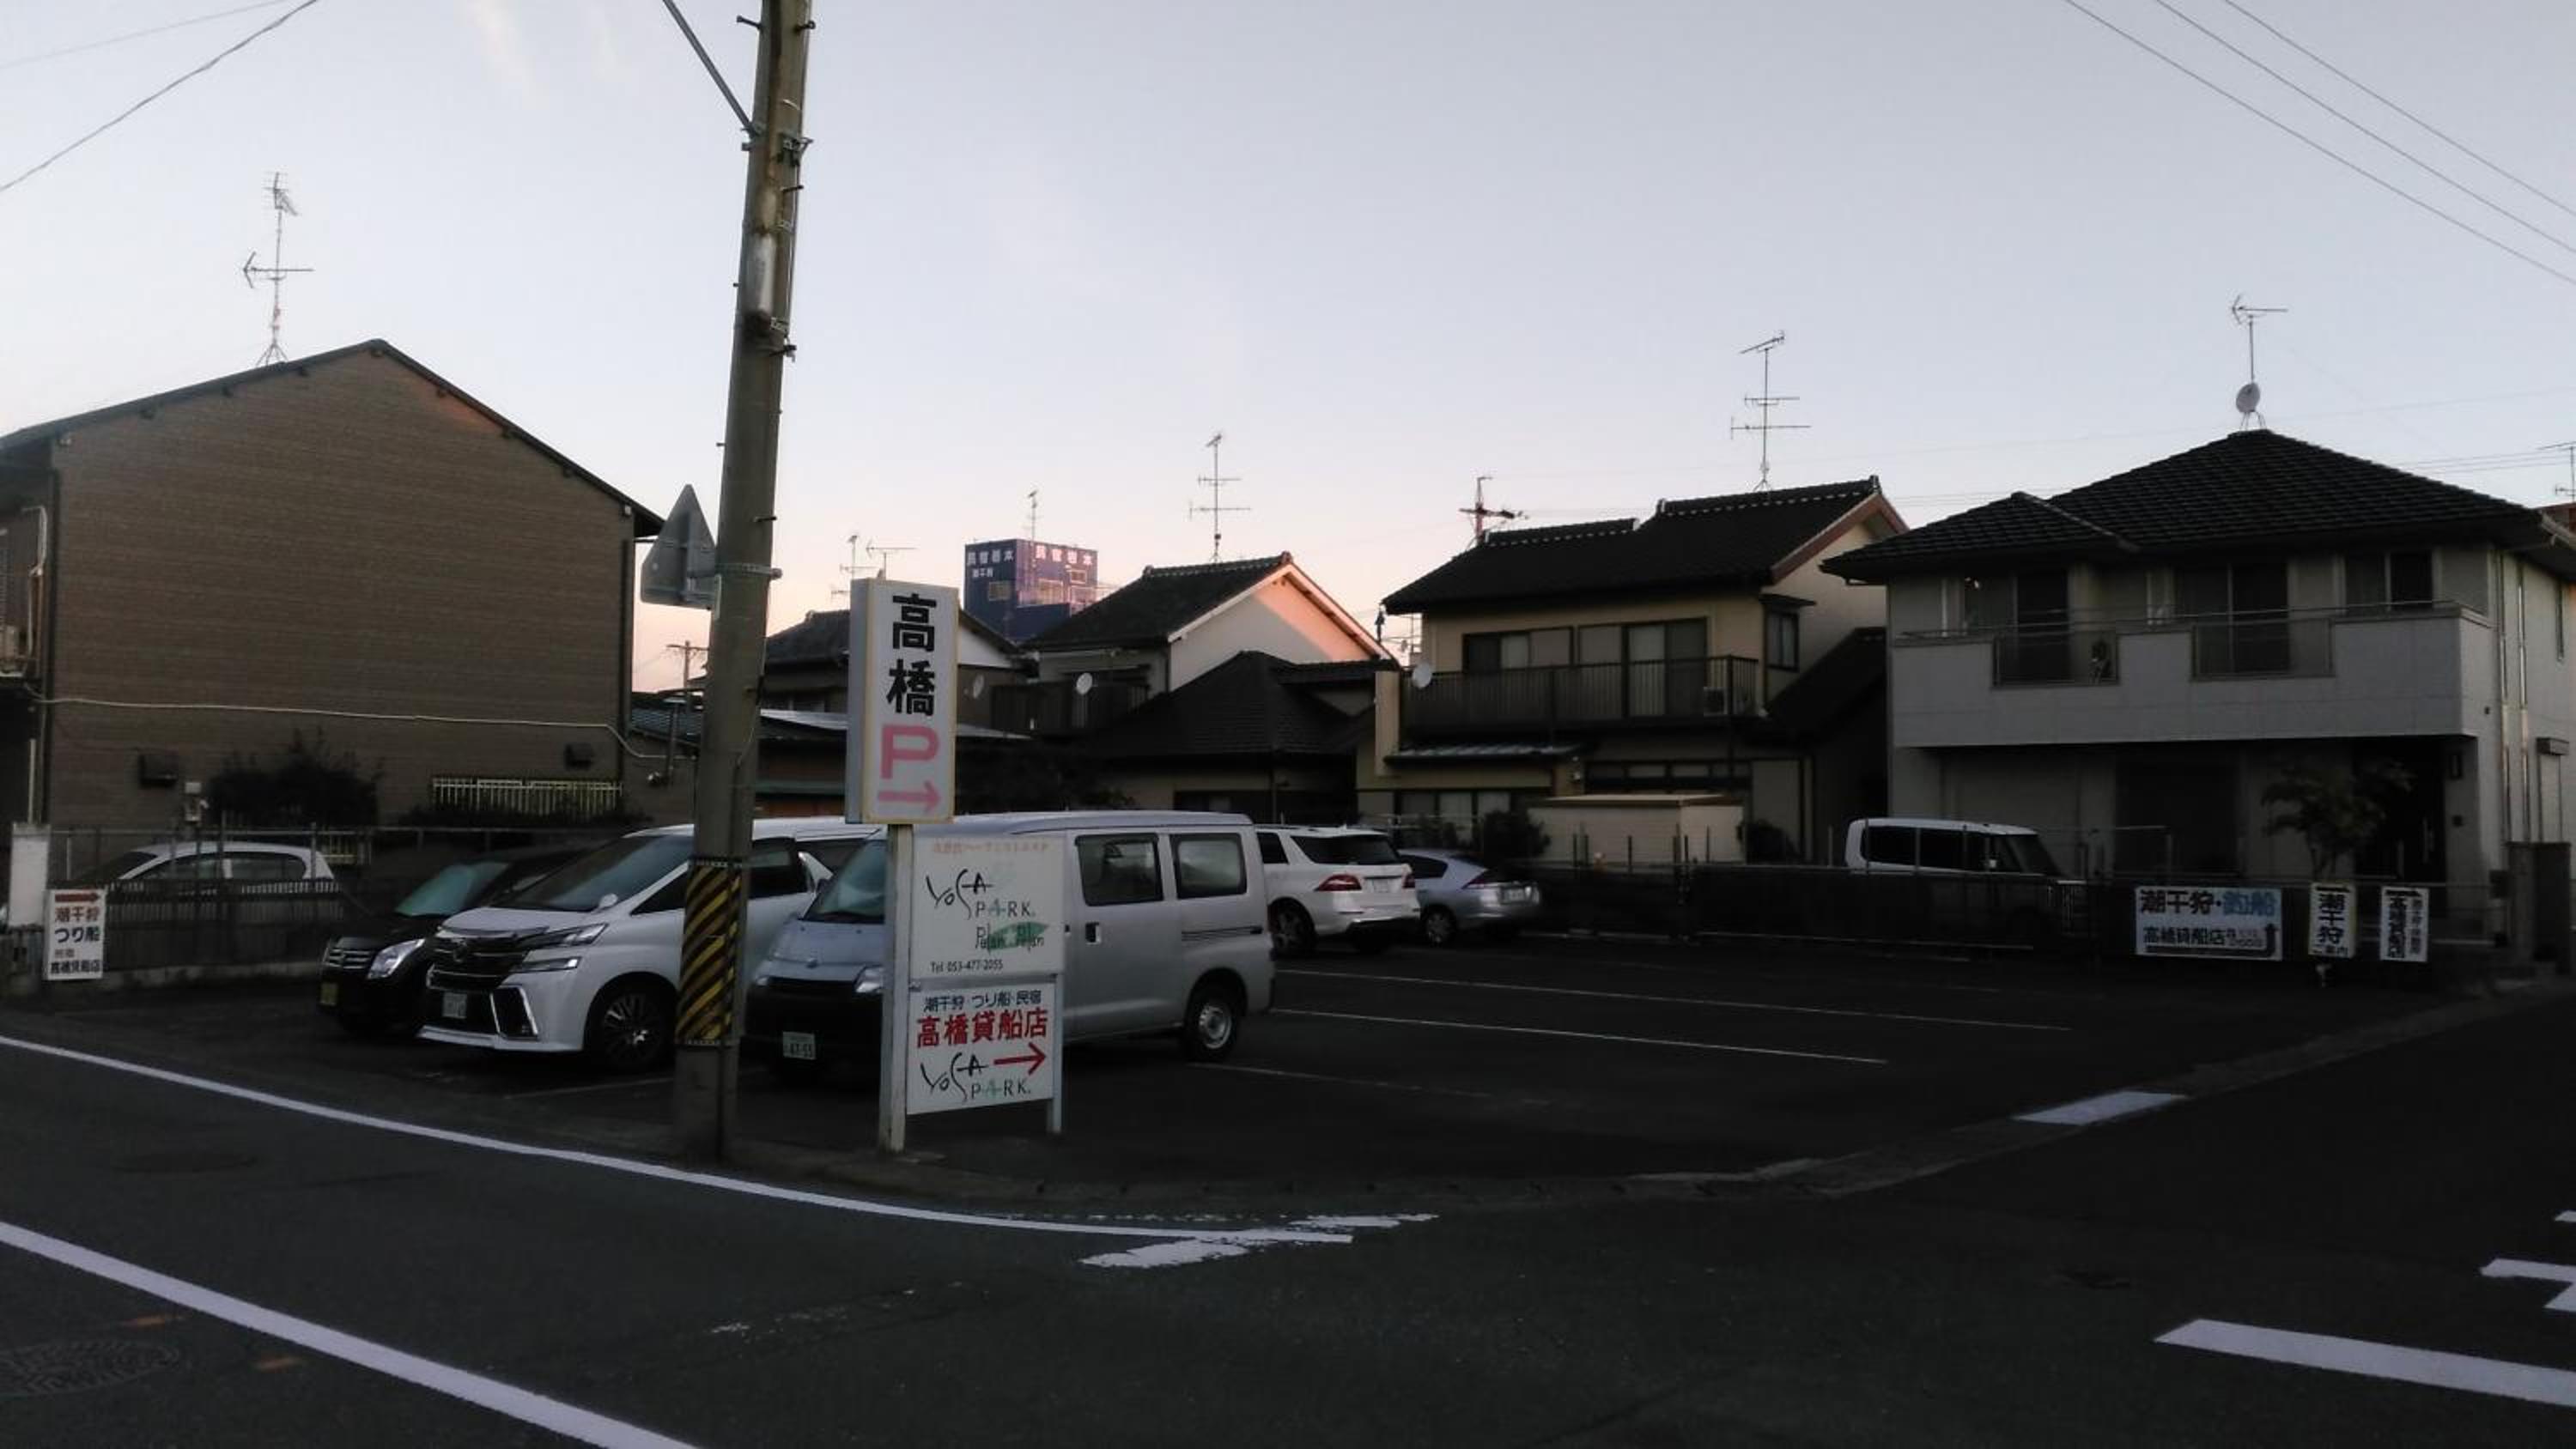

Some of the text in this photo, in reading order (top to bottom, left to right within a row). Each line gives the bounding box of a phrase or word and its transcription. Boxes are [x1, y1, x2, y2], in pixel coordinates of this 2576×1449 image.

[885, 593, 937, 716] 高橋
[880, 724, 940, 779] P
[54, 926, 100, 943] つり船
[2318, 894, 2345, 944] 潮干狩
[923, 996, 965, 1013] 潮干狩
[917, 1007, 1048, 1048] 高橋貸船店
